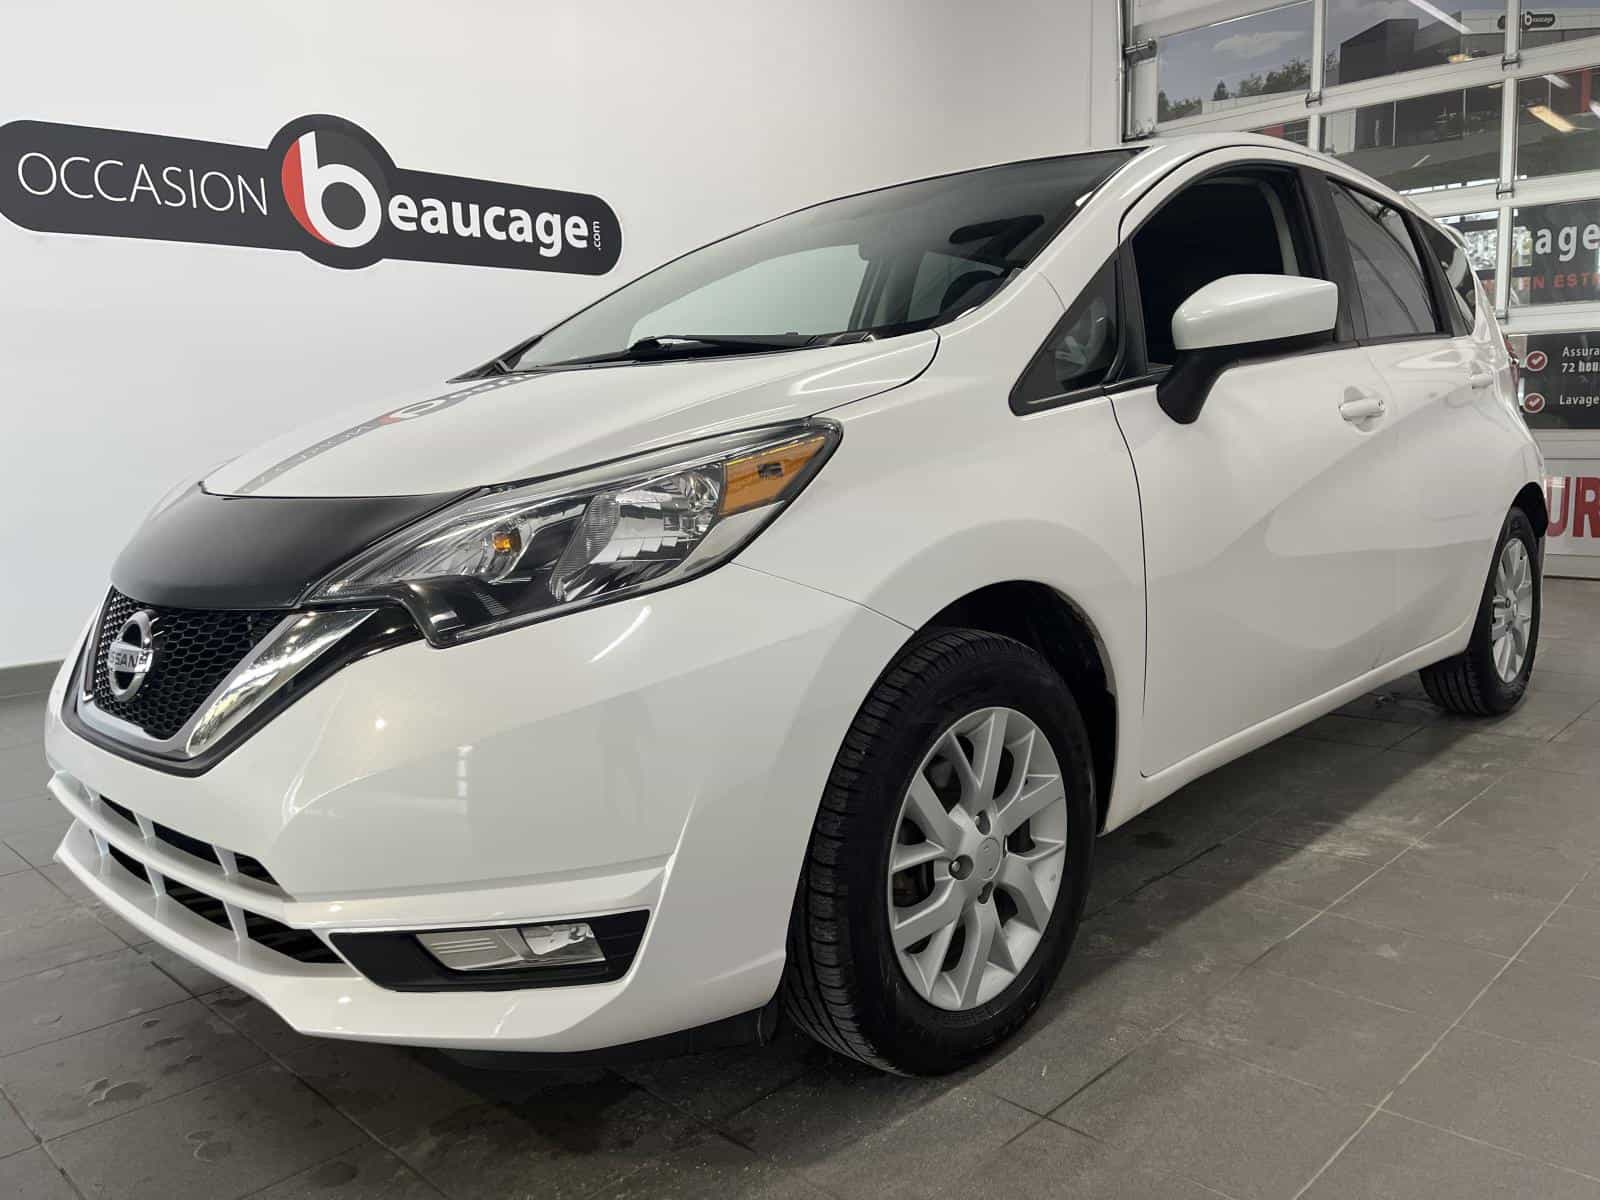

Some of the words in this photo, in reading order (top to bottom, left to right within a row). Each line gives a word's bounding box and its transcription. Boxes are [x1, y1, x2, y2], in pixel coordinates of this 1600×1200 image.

[17, 152, 268, 216] OCCASION
[298, 130, 590, 257] beaucage
[591, 220, 602, 251] .com
[1562, 346, 1600, 358] Assura
[1561, 362, 1576, 374] 72
[1578, 360, 1600, 373] hou
[1559, 394, 1600, 407] Lavage
